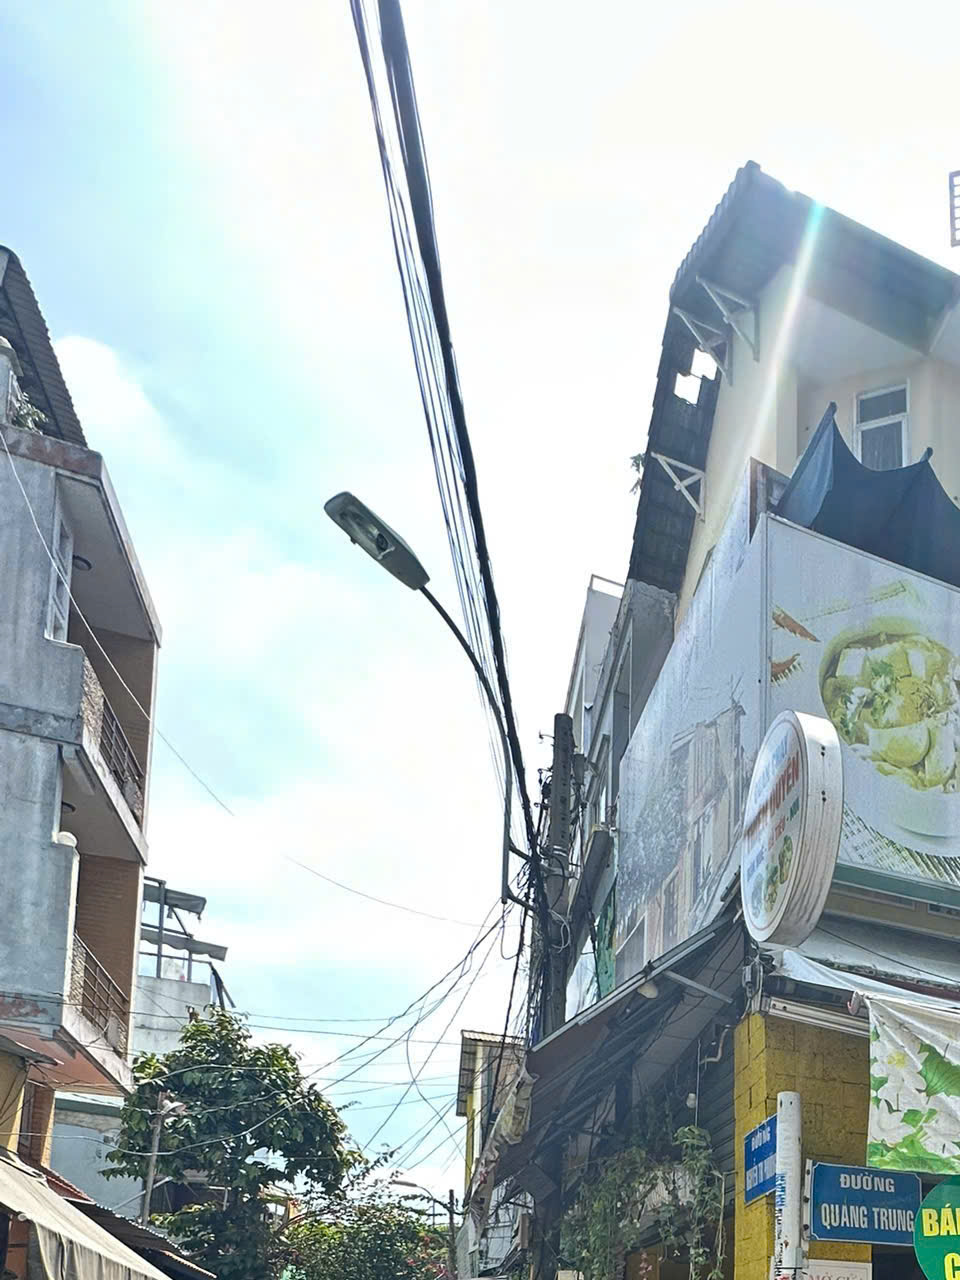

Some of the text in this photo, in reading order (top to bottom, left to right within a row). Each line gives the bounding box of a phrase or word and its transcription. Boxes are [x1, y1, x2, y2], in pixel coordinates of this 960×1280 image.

[840, 1172, 895, 1193] ĐƯỜNG
[821, 1203, 914, 1232] QUANG TRUNG
